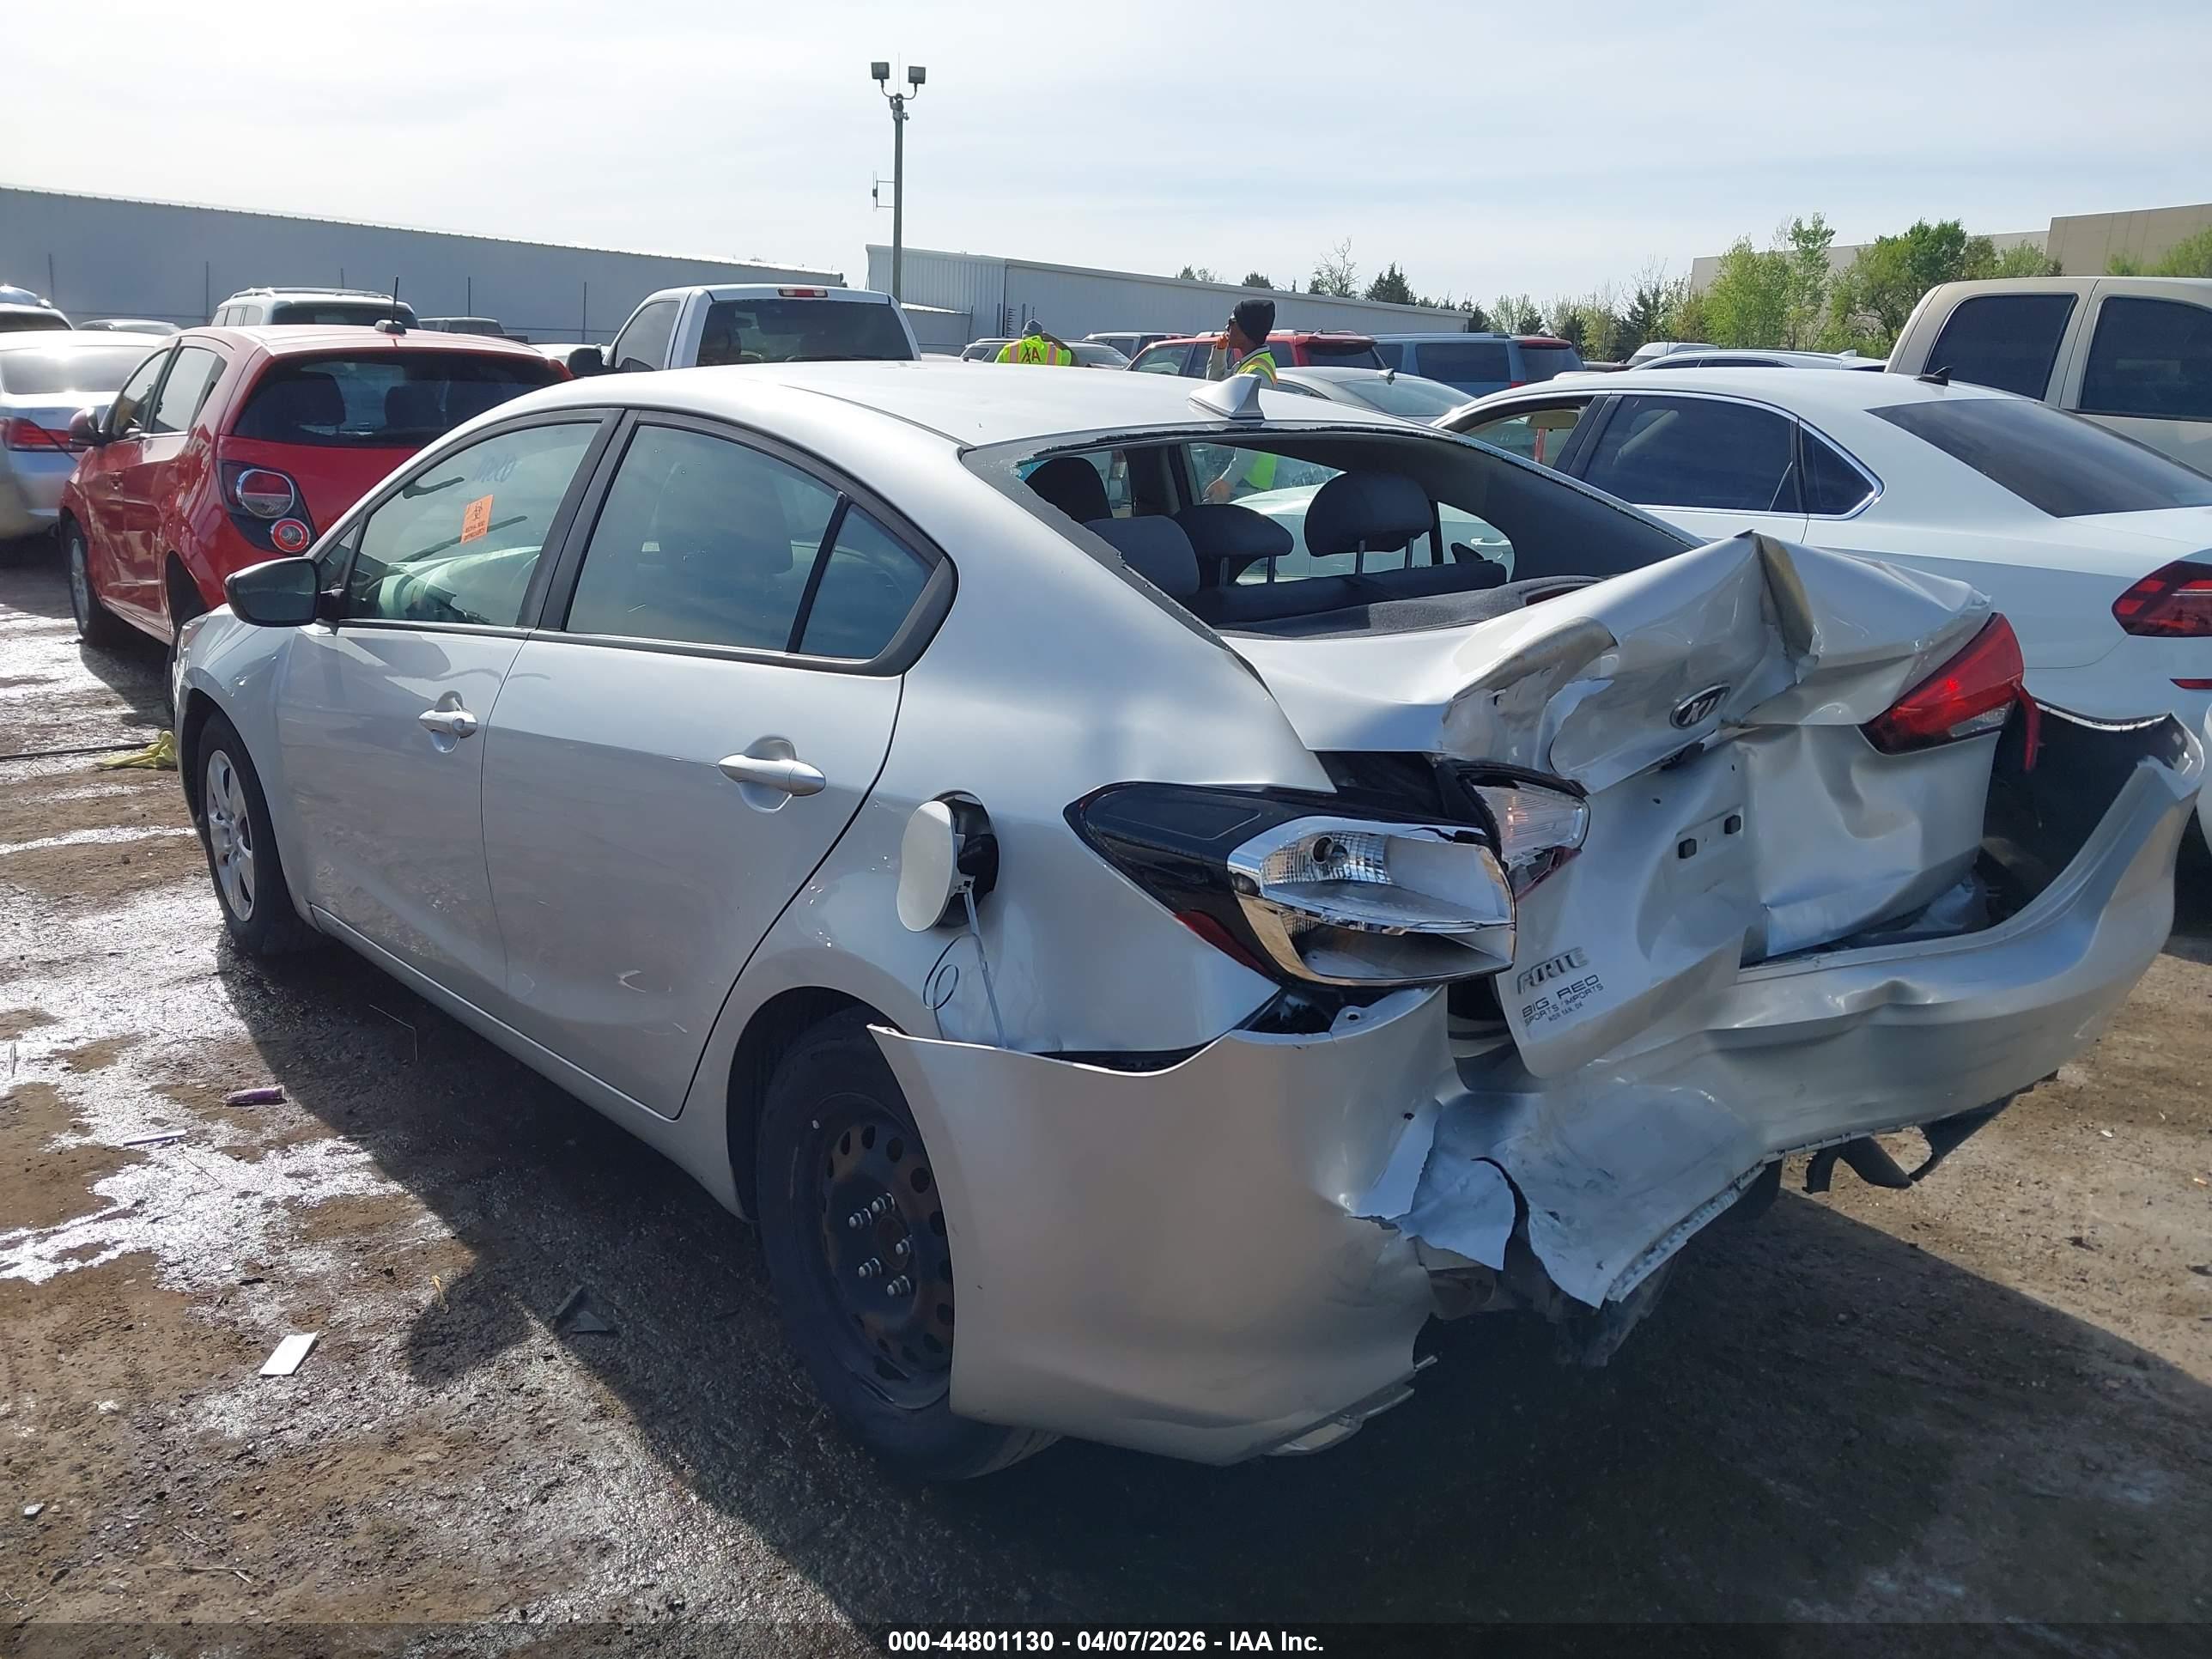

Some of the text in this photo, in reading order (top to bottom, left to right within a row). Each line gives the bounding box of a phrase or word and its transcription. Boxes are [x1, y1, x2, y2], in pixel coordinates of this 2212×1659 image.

[1517, 946, 1589, 994] FORTE
[1522, 975, 1599, 1018] BIG RED
[1524, 1004, 1559, 1026] SPORTS
